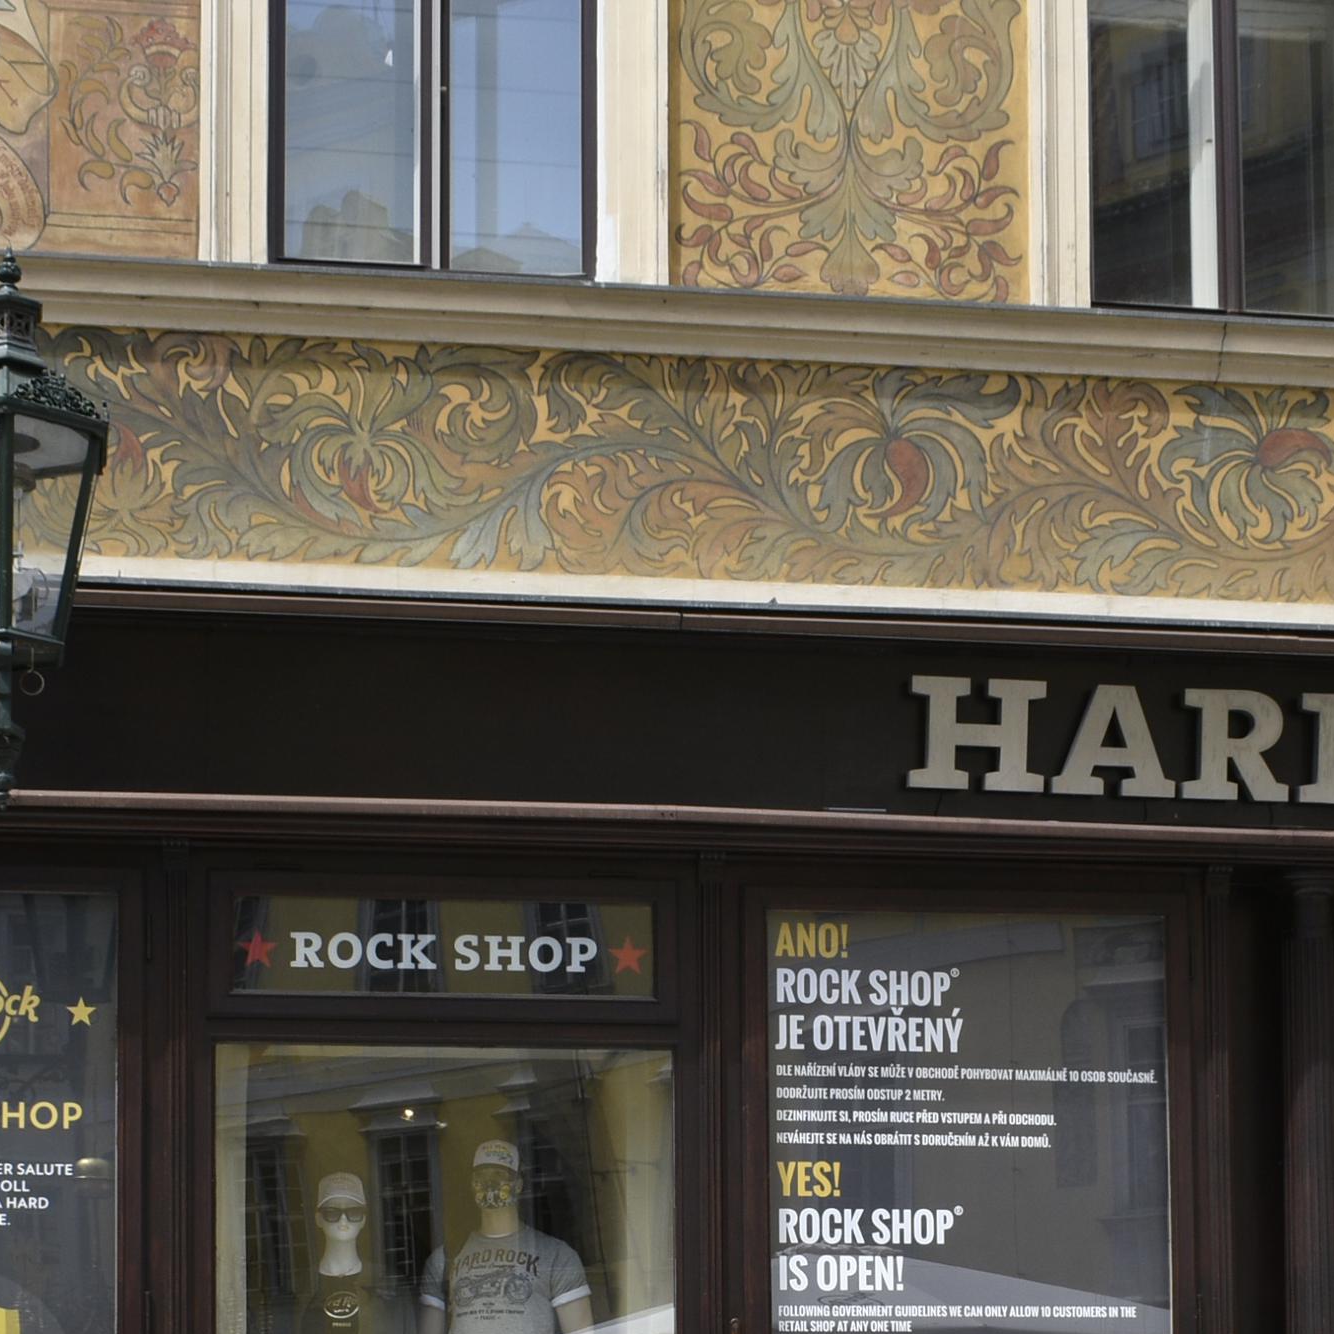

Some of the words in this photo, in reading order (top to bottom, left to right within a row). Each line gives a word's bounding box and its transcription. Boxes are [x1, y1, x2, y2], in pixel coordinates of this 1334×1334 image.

[290, 931, 435, 970] ROCK
[454, 934, 597, 973] SHOP
[775, 922, 847, 958] ANO!
[776, 967, 860, 1004] ROCK
[775, 1014, 805, 1051] JE
[812, 1007, 964, 1054] OTEVŘENÝ
[776, 1085, 827, 1099] DODRŽUJTE
[829, 1086, 864, 1100] PROSÍM
[867, 1088, 903, 1100] ODSTUP
[905, 1088, 910, 1100] 2
[17, 1162, 72, 1175] SALUTE
[778, 1160, 840, 1197] YES!
[6, 1196, 49, 1209] HARD
[778, 1207, 863, 1245] ROCK
[494, 1248, 540, 1277] ROCK
[779, 1254, 808, 1291] IS
[816, 1254, 904, 1291] OPEN!
[778, 1304, 830, 1317] FOLLOWING
[831, 1304, 892, 1317] GOVERNMENT
[894, 1305, 947, 1317] GUIDELINES
[949, 1305, 961, 1317] WE
[963, 1305, 982, 1317] CAN
[984, 1305, 1007, 1317] ONLY
[1009, 1305, 1039, 1317] ALLOW
[1041, 1305, 1051, 1317] 10
[1052, 1305, 1107, 1318] CUSTOMERS
[1108, 1306, 1118, 1317] IN
[1120, 1306, 1136, 1318] THE
[778, 1319, 807, 1332] RETAIL
[810, 1319, 835, 1332] SHOP
[837, 1319, 848, 1332] AT
[850, 1319, 868, 1332] ANY
[870, 1319, 888, 1332] ONE
[890, 1320, 912, 1332] TIME
